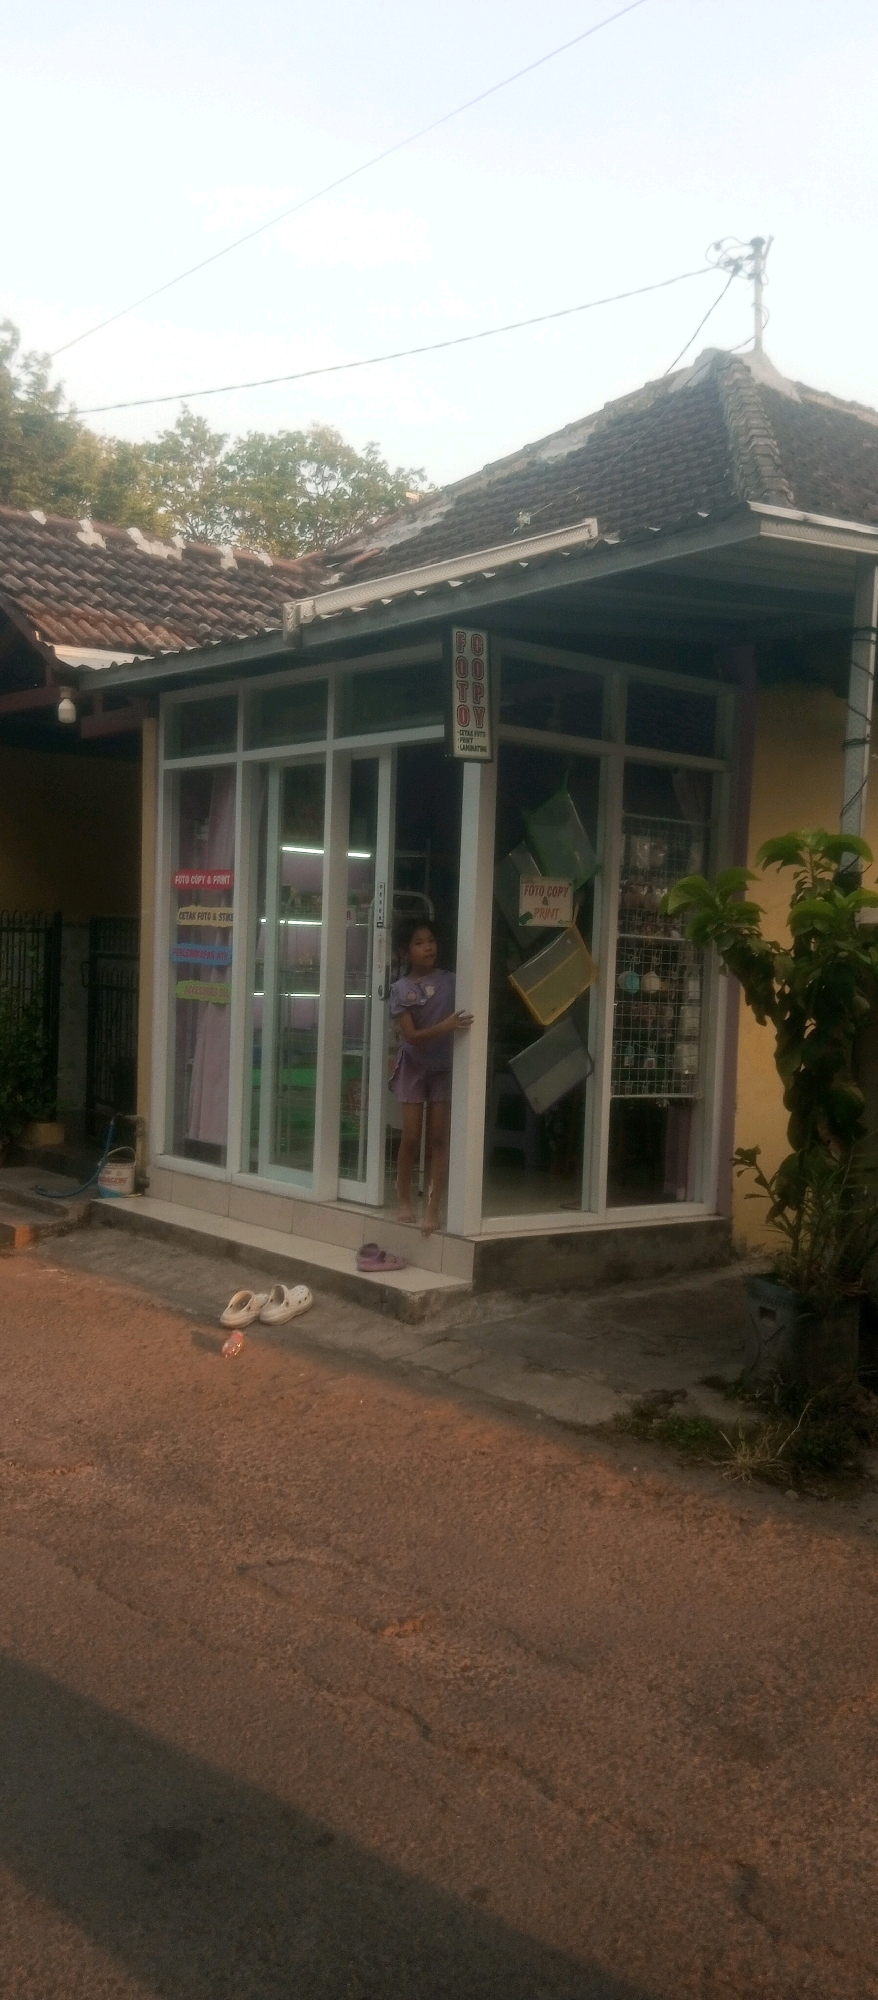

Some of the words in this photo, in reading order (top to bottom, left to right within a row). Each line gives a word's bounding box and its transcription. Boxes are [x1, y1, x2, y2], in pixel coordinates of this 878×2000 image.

[456, 630, 469, 727] FOTO
[470, 633, 485, 729] COPY
[174, 875, 190, 885] FOTO
[191, 875, 206, 885] COPY
[213, 875, 231, 885] PRINT
[523, 884, 545, 897] FOTO
[546, 885, 569, 898] COPY
[178, 911, 197, 920] CETAK
[197, 911, 212, 921] FOTO
[534, 907, 560, 921] PRINT
